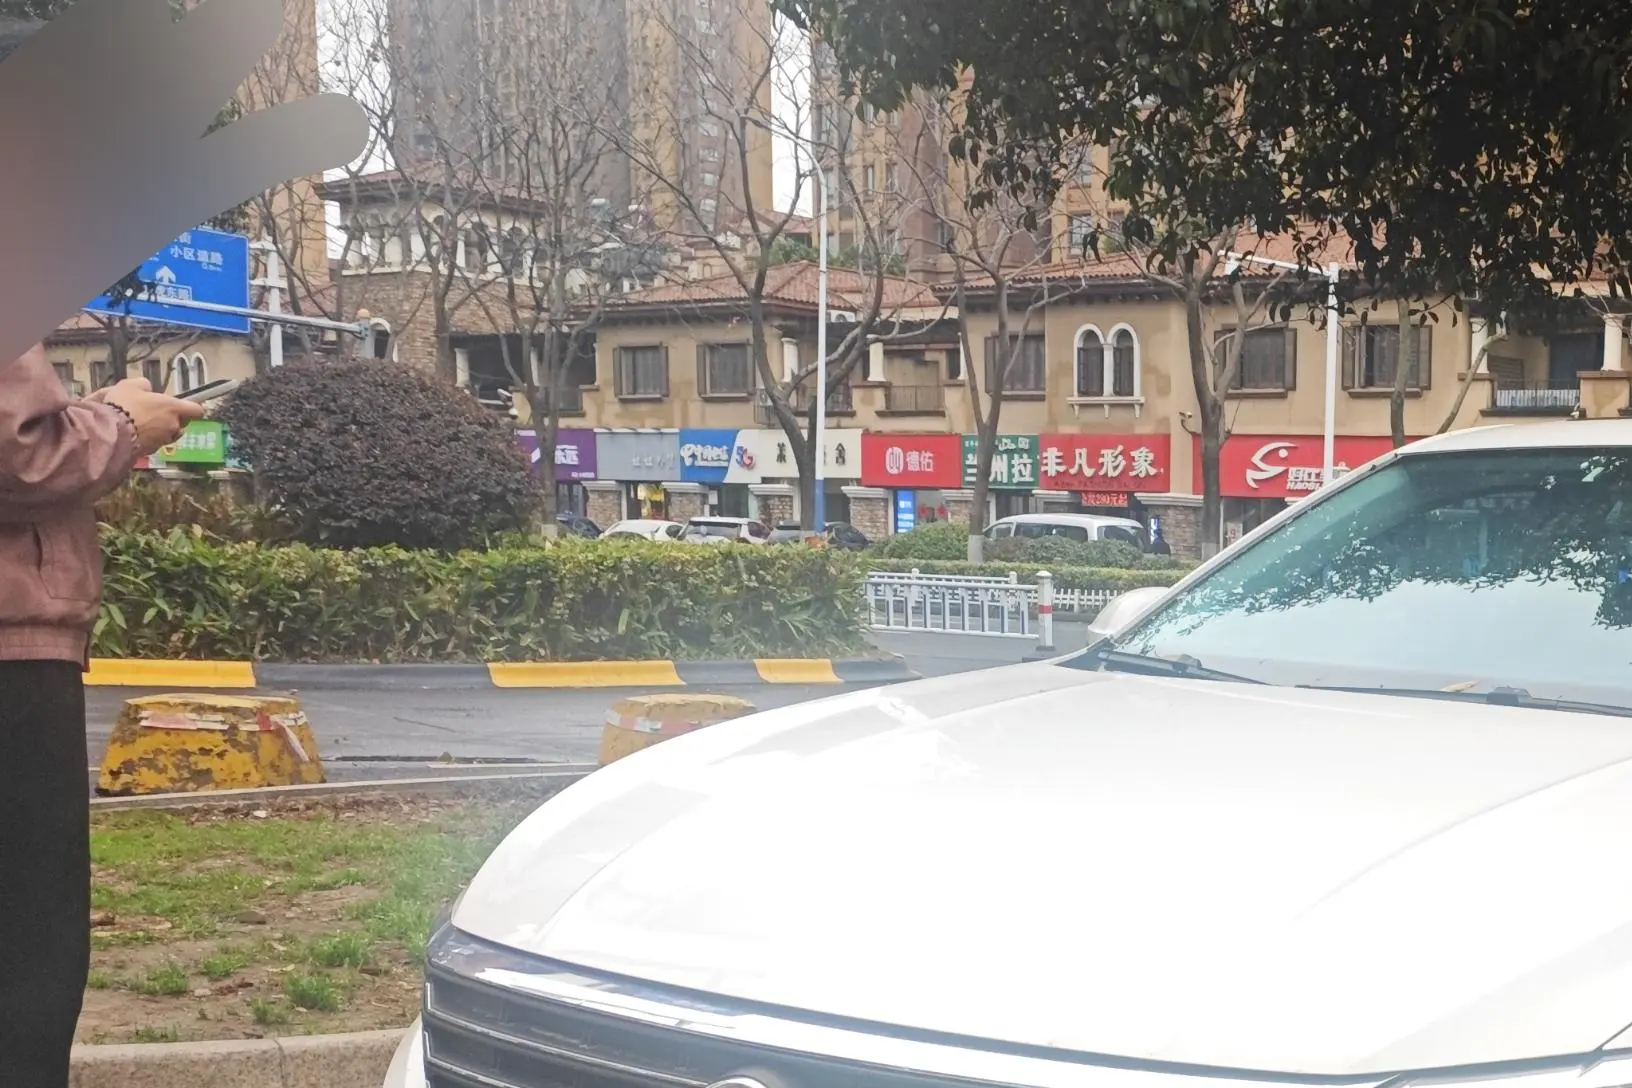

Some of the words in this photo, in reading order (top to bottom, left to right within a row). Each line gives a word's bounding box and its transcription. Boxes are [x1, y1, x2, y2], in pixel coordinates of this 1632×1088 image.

[906, 450, 934, 472] 德佑
[964, 453, 1040, 483] 兰州拉
[1041, 445, 1158, 477] 非凡形象
